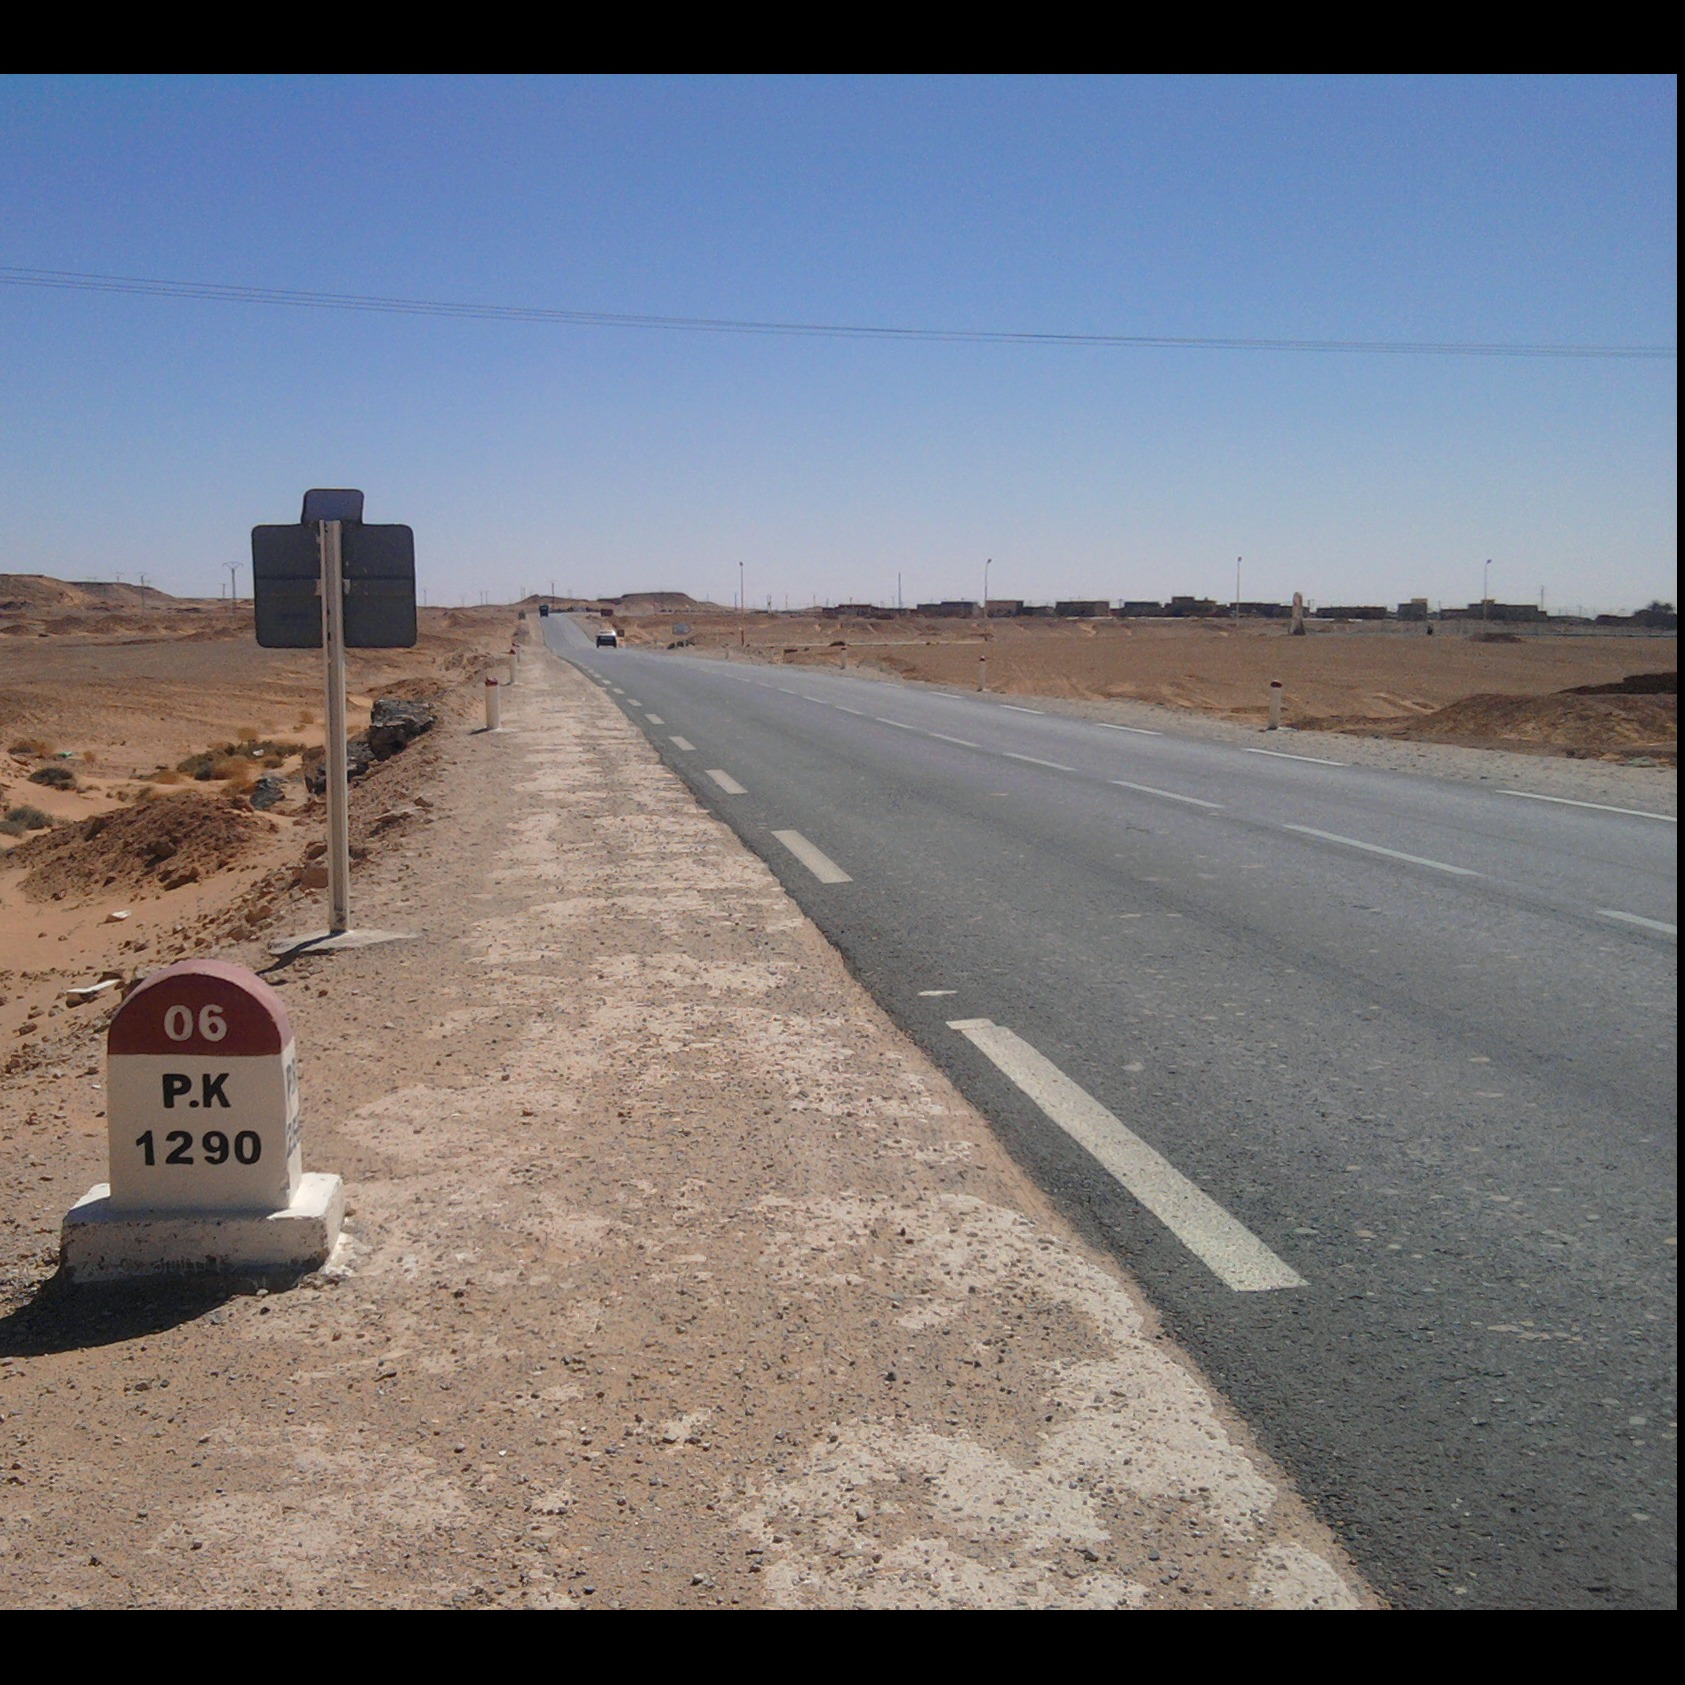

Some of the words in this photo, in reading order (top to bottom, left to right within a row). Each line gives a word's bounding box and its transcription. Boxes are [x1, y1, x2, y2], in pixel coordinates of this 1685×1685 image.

[164, 1004, 228, 1041] 06
[162, 1073, 230, 1108] P.K
[136, 1131, 261, 1165] 1290
